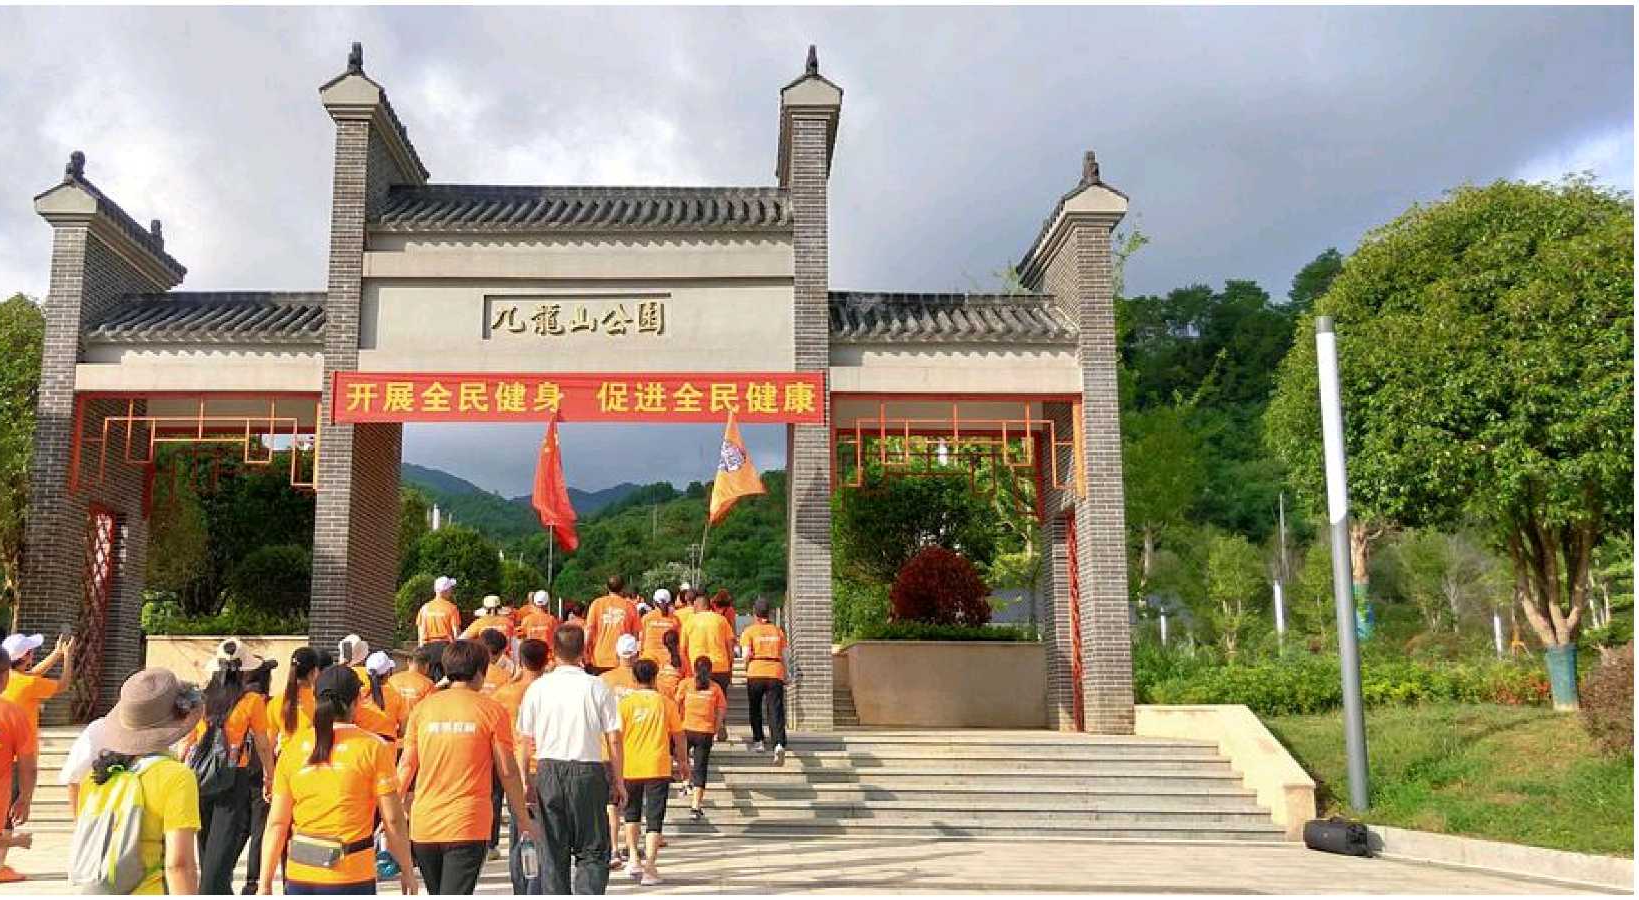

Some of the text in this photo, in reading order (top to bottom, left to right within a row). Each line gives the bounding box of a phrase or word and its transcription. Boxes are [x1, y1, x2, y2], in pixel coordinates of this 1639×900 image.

[346, 381, 815, 413] 开展全民健身 促进全民健康
